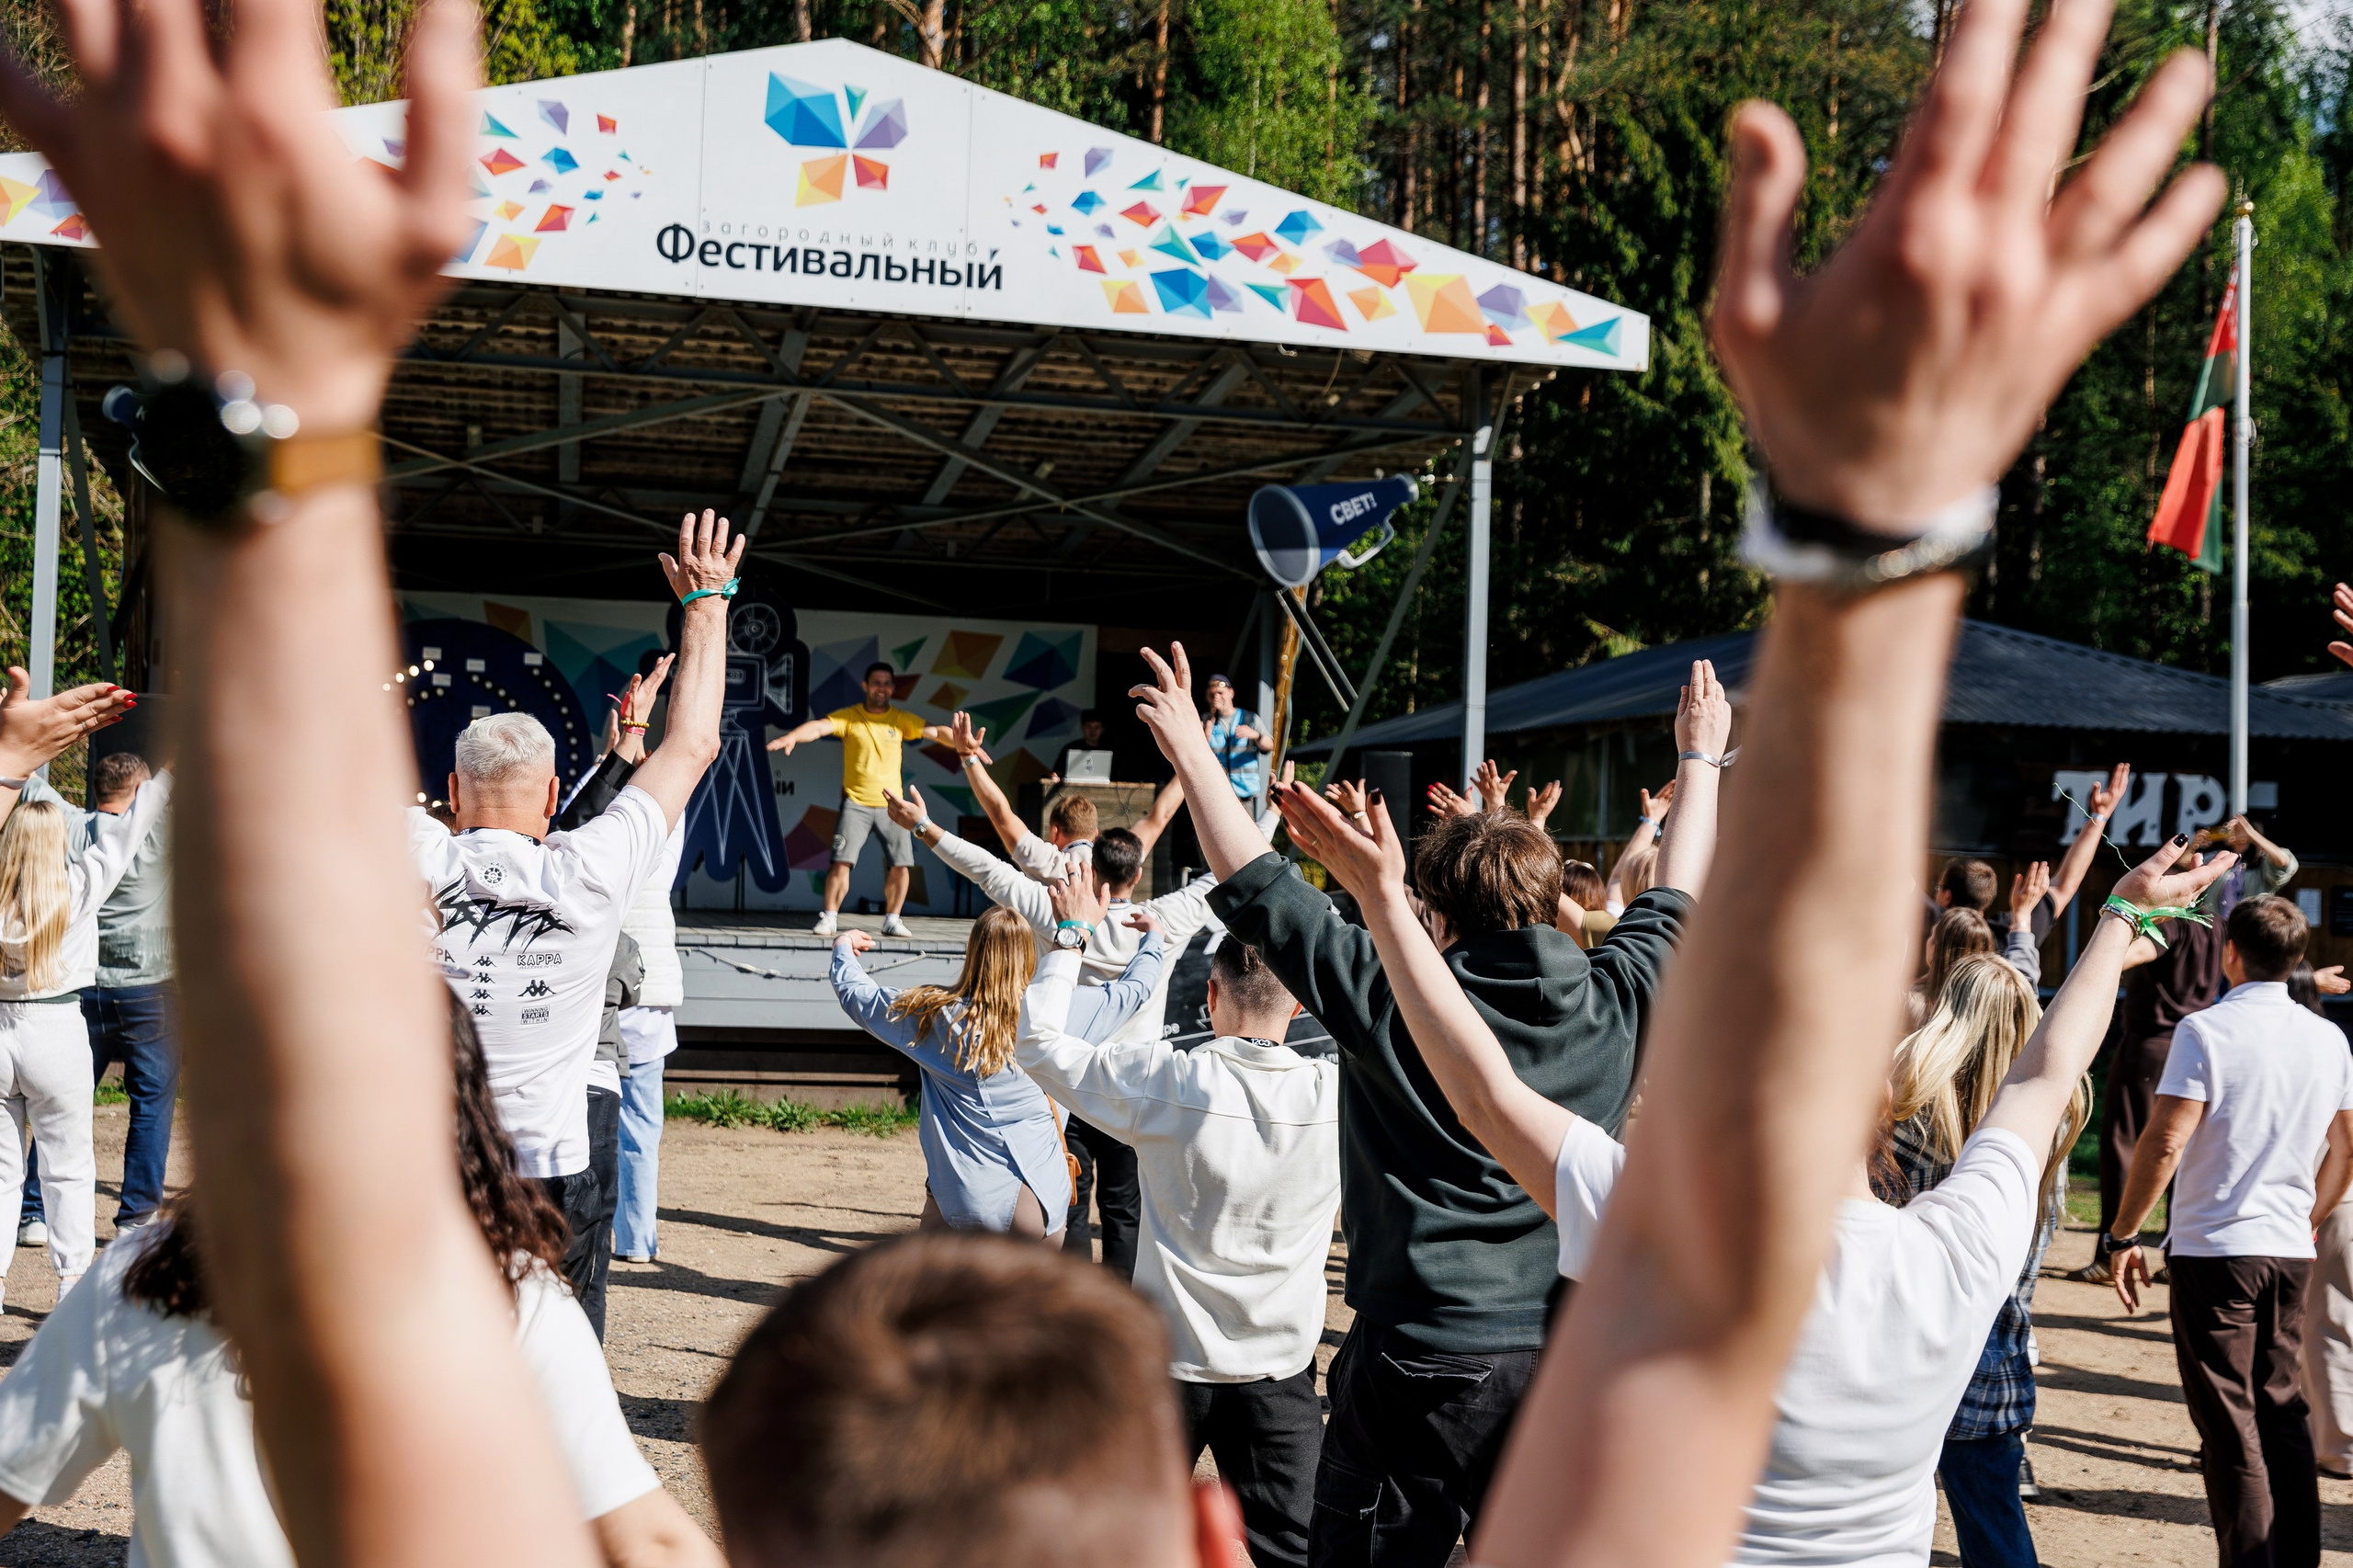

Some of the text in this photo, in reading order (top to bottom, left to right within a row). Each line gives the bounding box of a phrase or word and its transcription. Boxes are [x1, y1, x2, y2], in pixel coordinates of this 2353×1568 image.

[701, 220, 978, 257] загородный клуб
[655, 222, 1004, 290] Фестивальный
[1329, 491, 1379, 527] СВЕТ!
[2052, 770, 2226, 846] ТИР
[425, 947, 456, 963] PPA
[517, 952, 563, 966] KAPPA
[522, 1017, 549, 1025] WITHIN
[523, 1006, 549, 1014] WINNING
